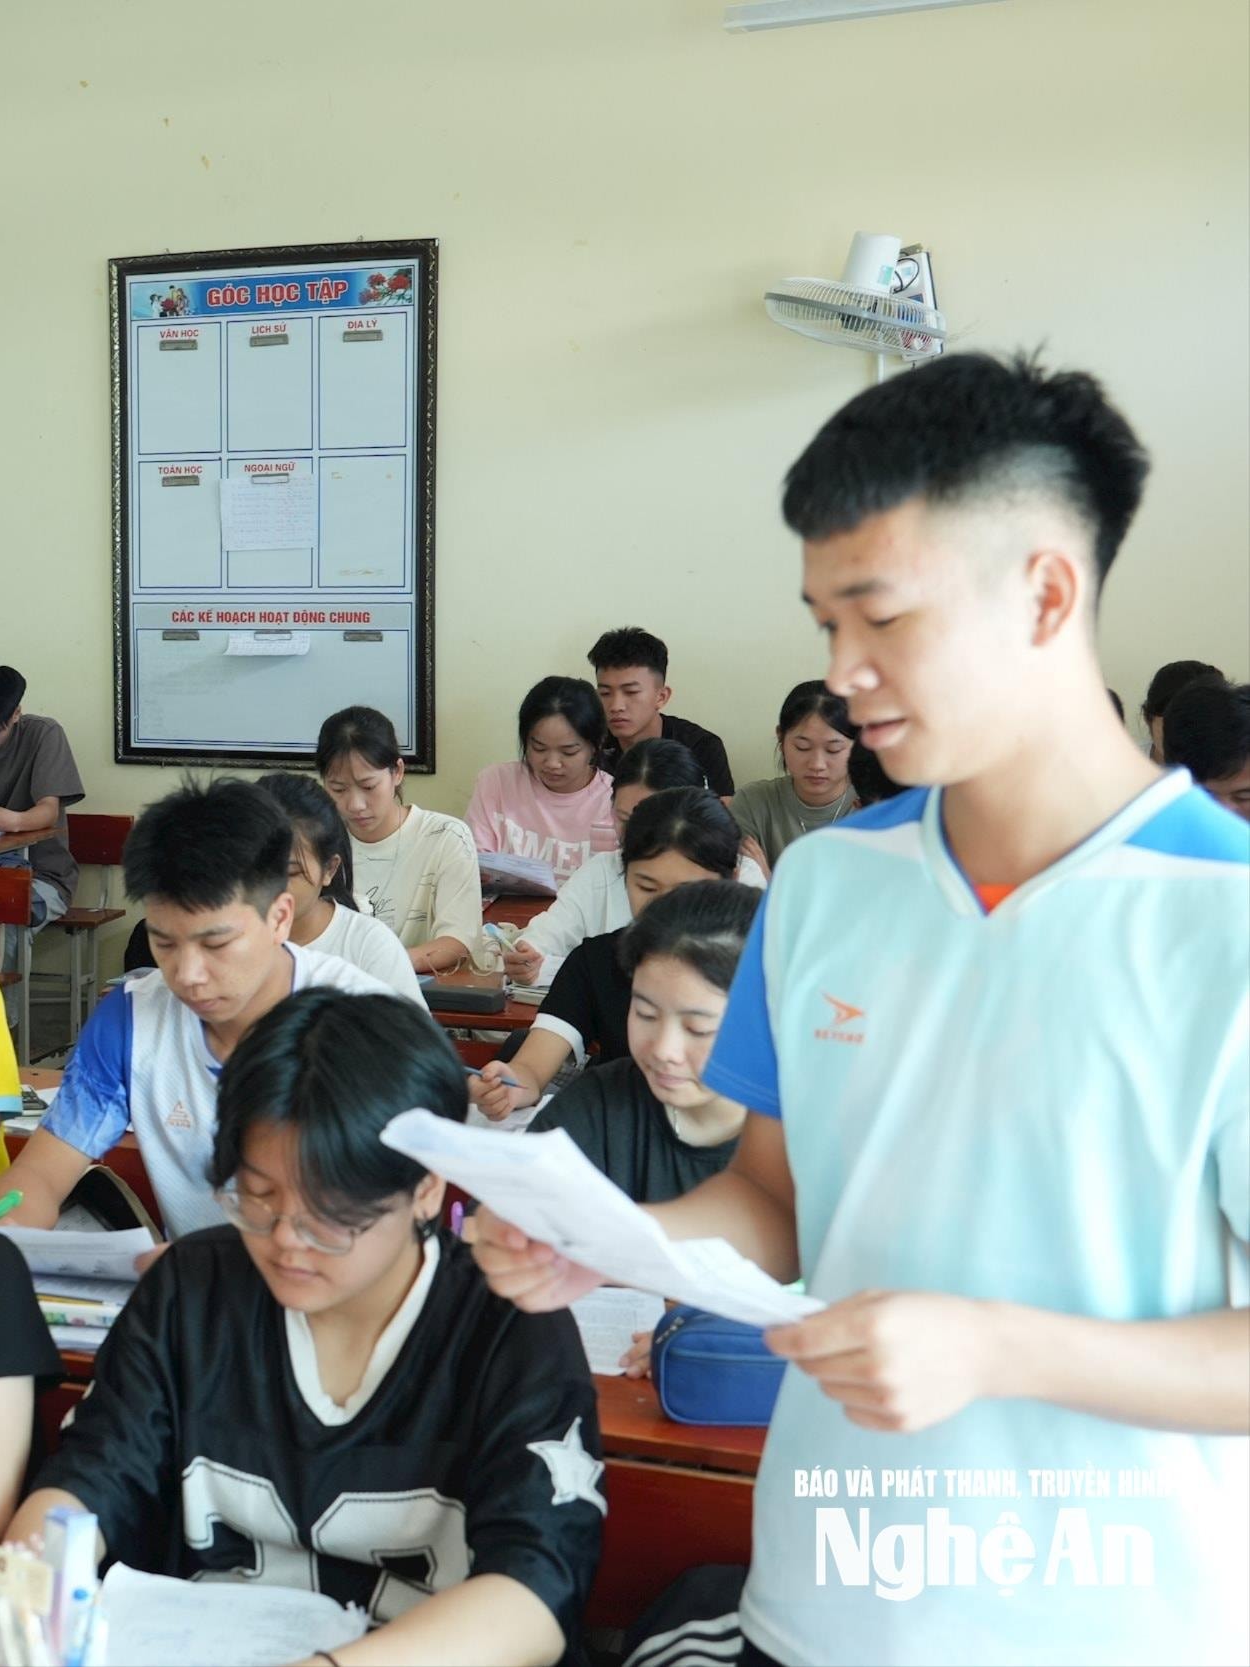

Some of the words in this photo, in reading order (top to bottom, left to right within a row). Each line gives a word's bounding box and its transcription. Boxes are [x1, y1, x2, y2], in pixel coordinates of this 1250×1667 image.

[207, 283, 250, 306] GÓC
[256, 282, 300, 306] HỌC
[305, 277, 348, 304] TẬP
[172, 608, 195, 623] CÁC
[198, 608, 214, 623] KẾ
[216, 611, 255, 625] HOẠCH
[259, 611, 290, 626] HOẠT
[293, 609, 326, 626] ĐỘNG
[329, 611, 371, 624] CHUNG
